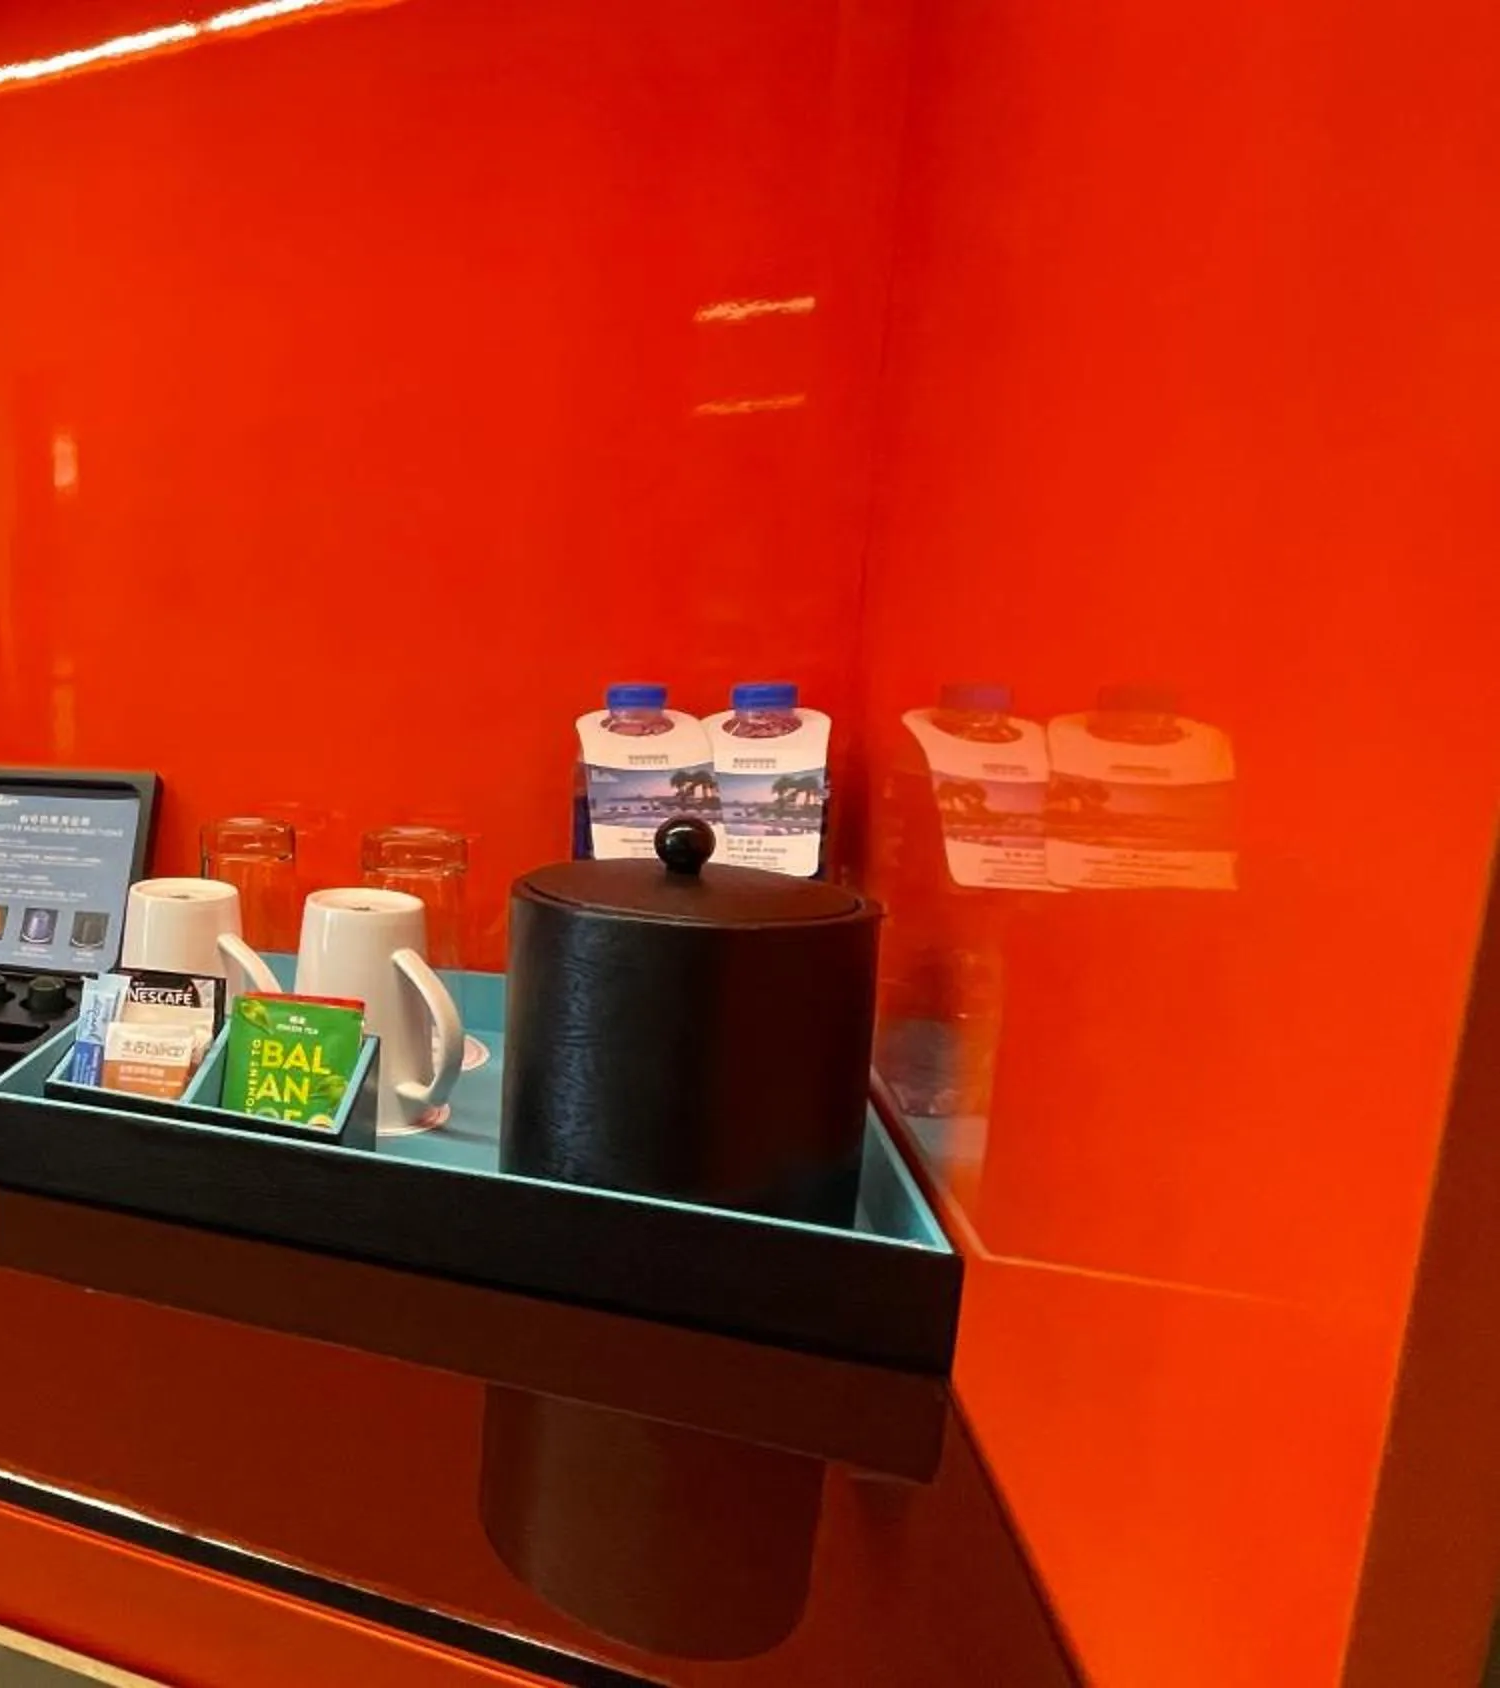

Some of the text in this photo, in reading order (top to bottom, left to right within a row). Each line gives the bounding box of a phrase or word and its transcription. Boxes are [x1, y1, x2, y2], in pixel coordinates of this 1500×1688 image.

[251, 1039, 261, 1057] TO
[261, 1039, 331, 1075] BAL
[255, 1073, 310, 1105] AN
